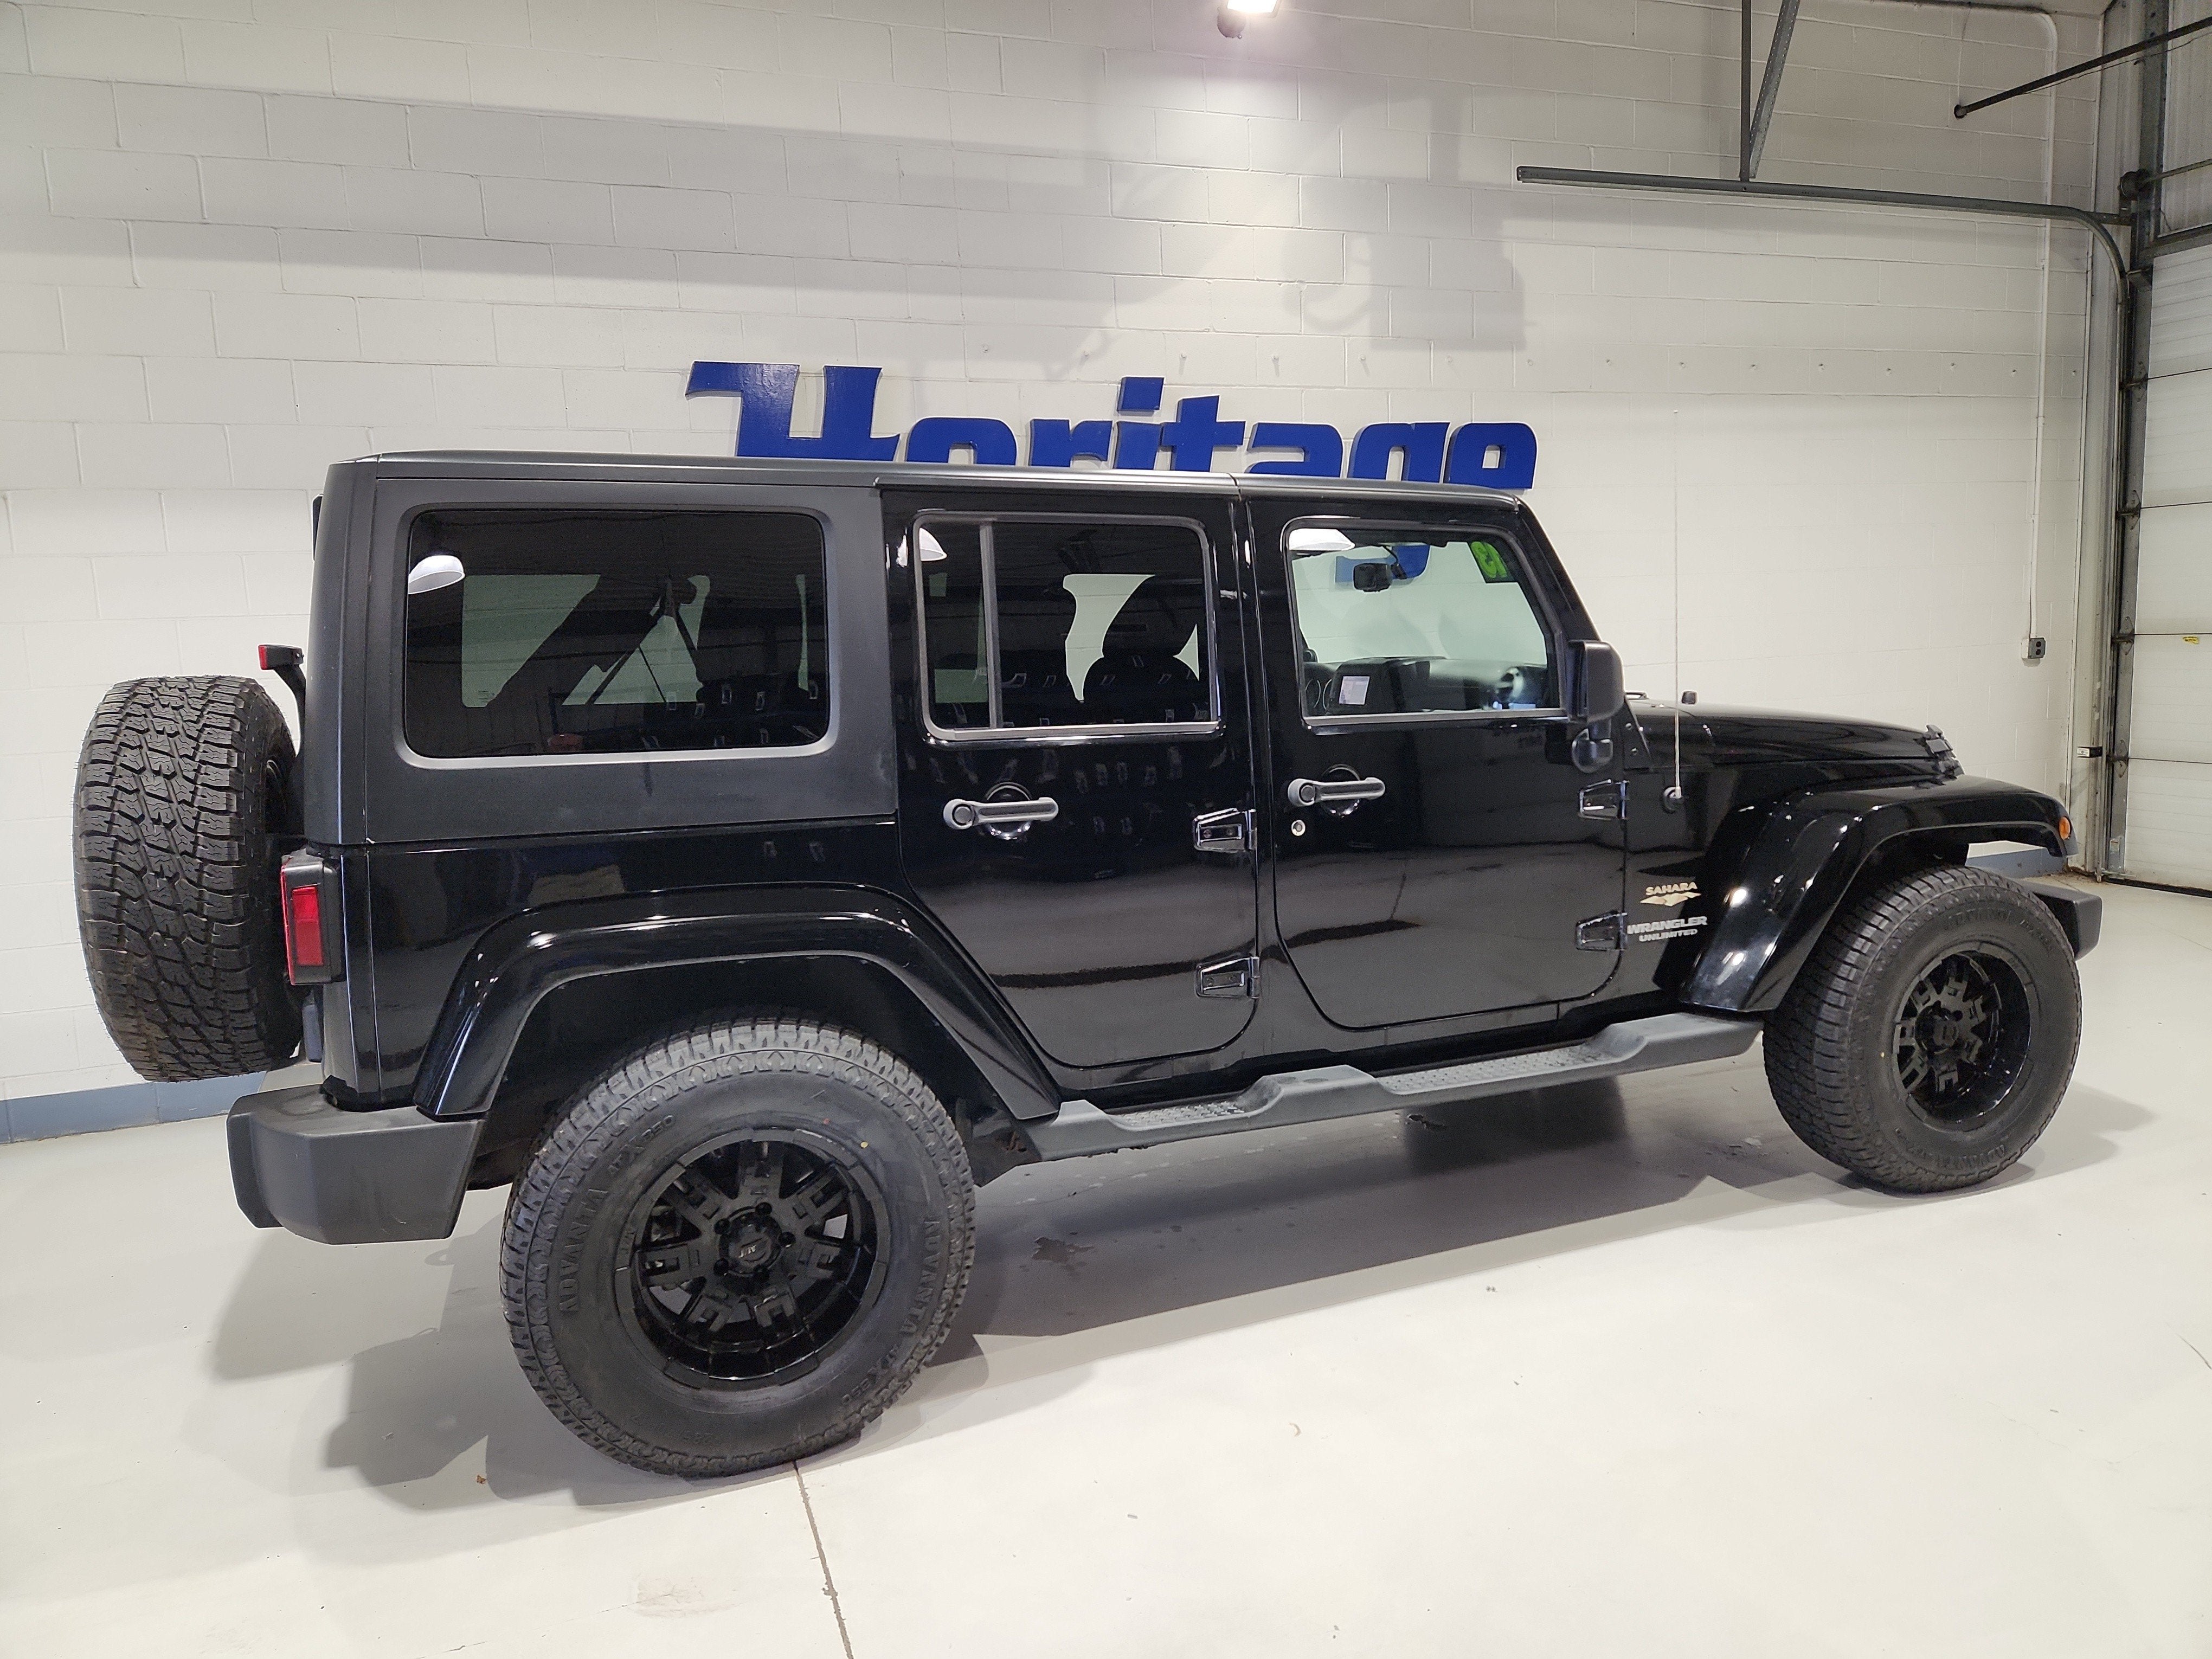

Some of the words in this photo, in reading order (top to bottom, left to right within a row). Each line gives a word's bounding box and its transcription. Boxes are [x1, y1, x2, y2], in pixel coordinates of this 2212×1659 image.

[1645, 882, 1698, 896] SAHARA
[1627, 916, 1708, 935] WRANGLER
[1639, 928, 1698, 942] UNLIMITED
[558, 1188, 609, 1313] ADVANTA
[899, 1220, 941, 1334] ADVANTA
